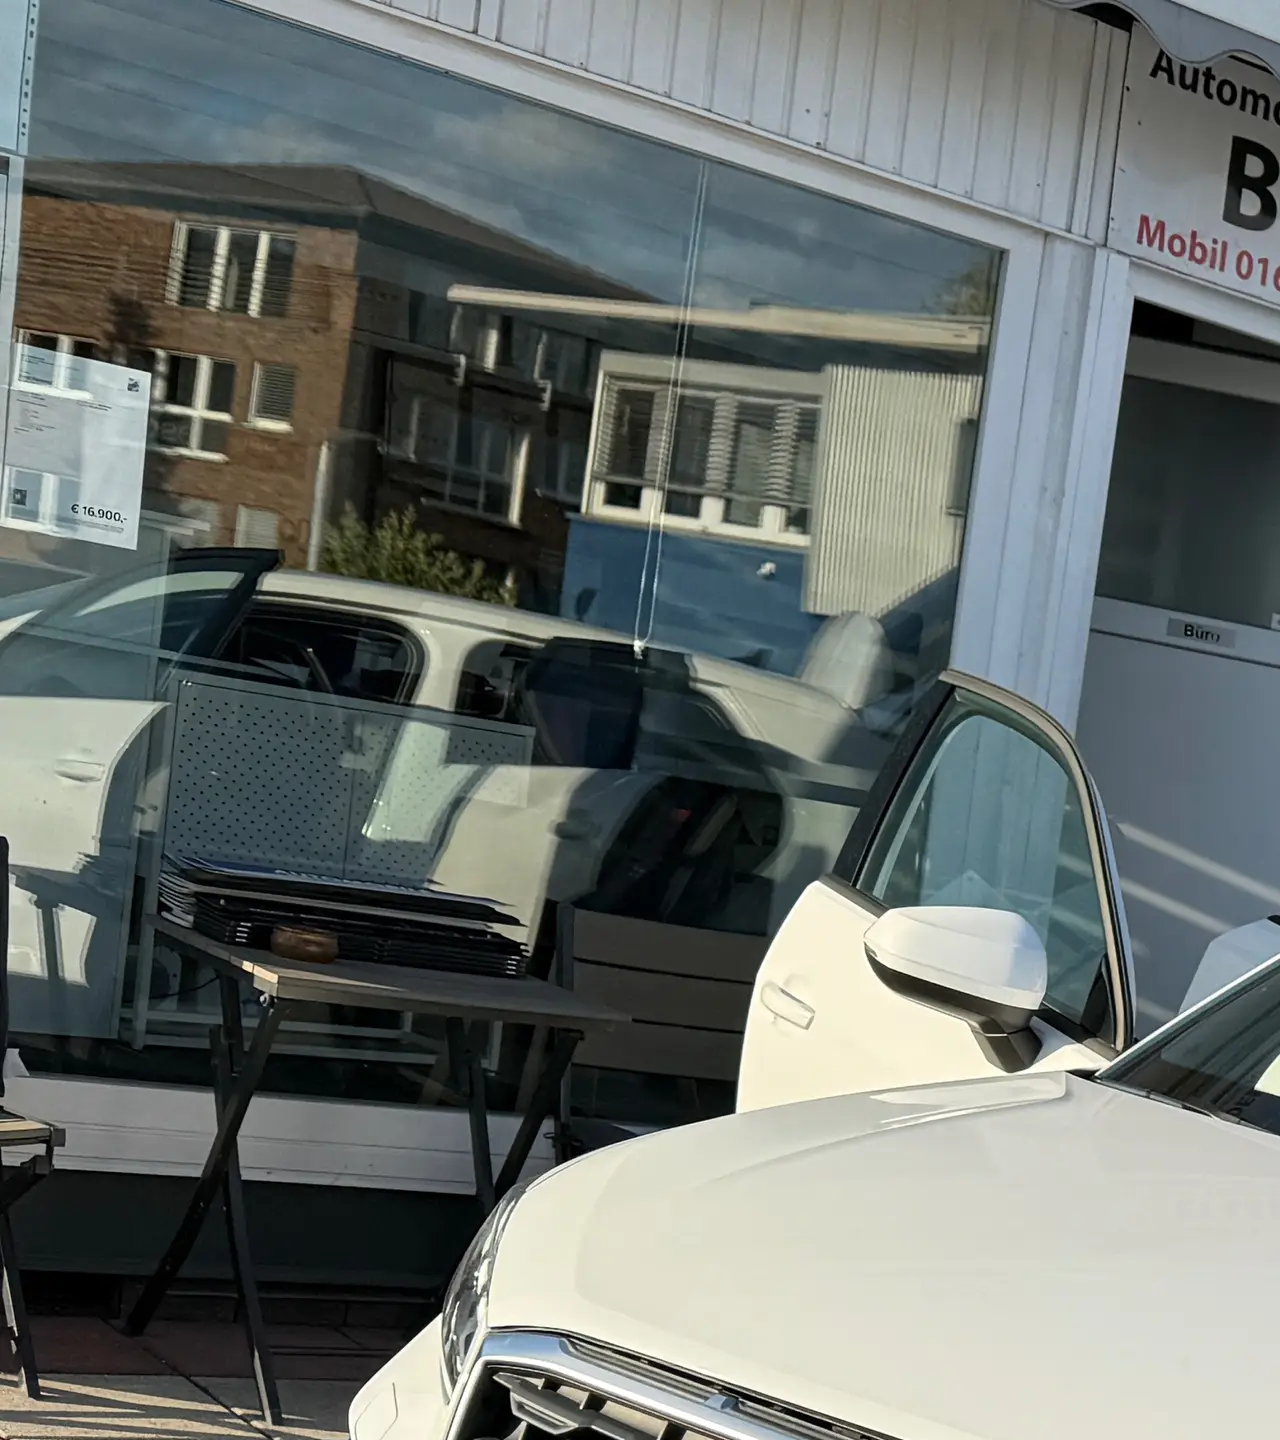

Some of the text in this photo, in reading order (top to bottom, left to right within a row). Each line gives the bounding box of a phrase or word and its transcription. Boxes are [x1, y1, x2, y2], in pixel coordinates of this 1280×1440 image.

[1136, 213, 1228, 273] Mobil
[71, 503, 128, 524] € 16.900,-
[1184, 624, 1220, 642] Büro
